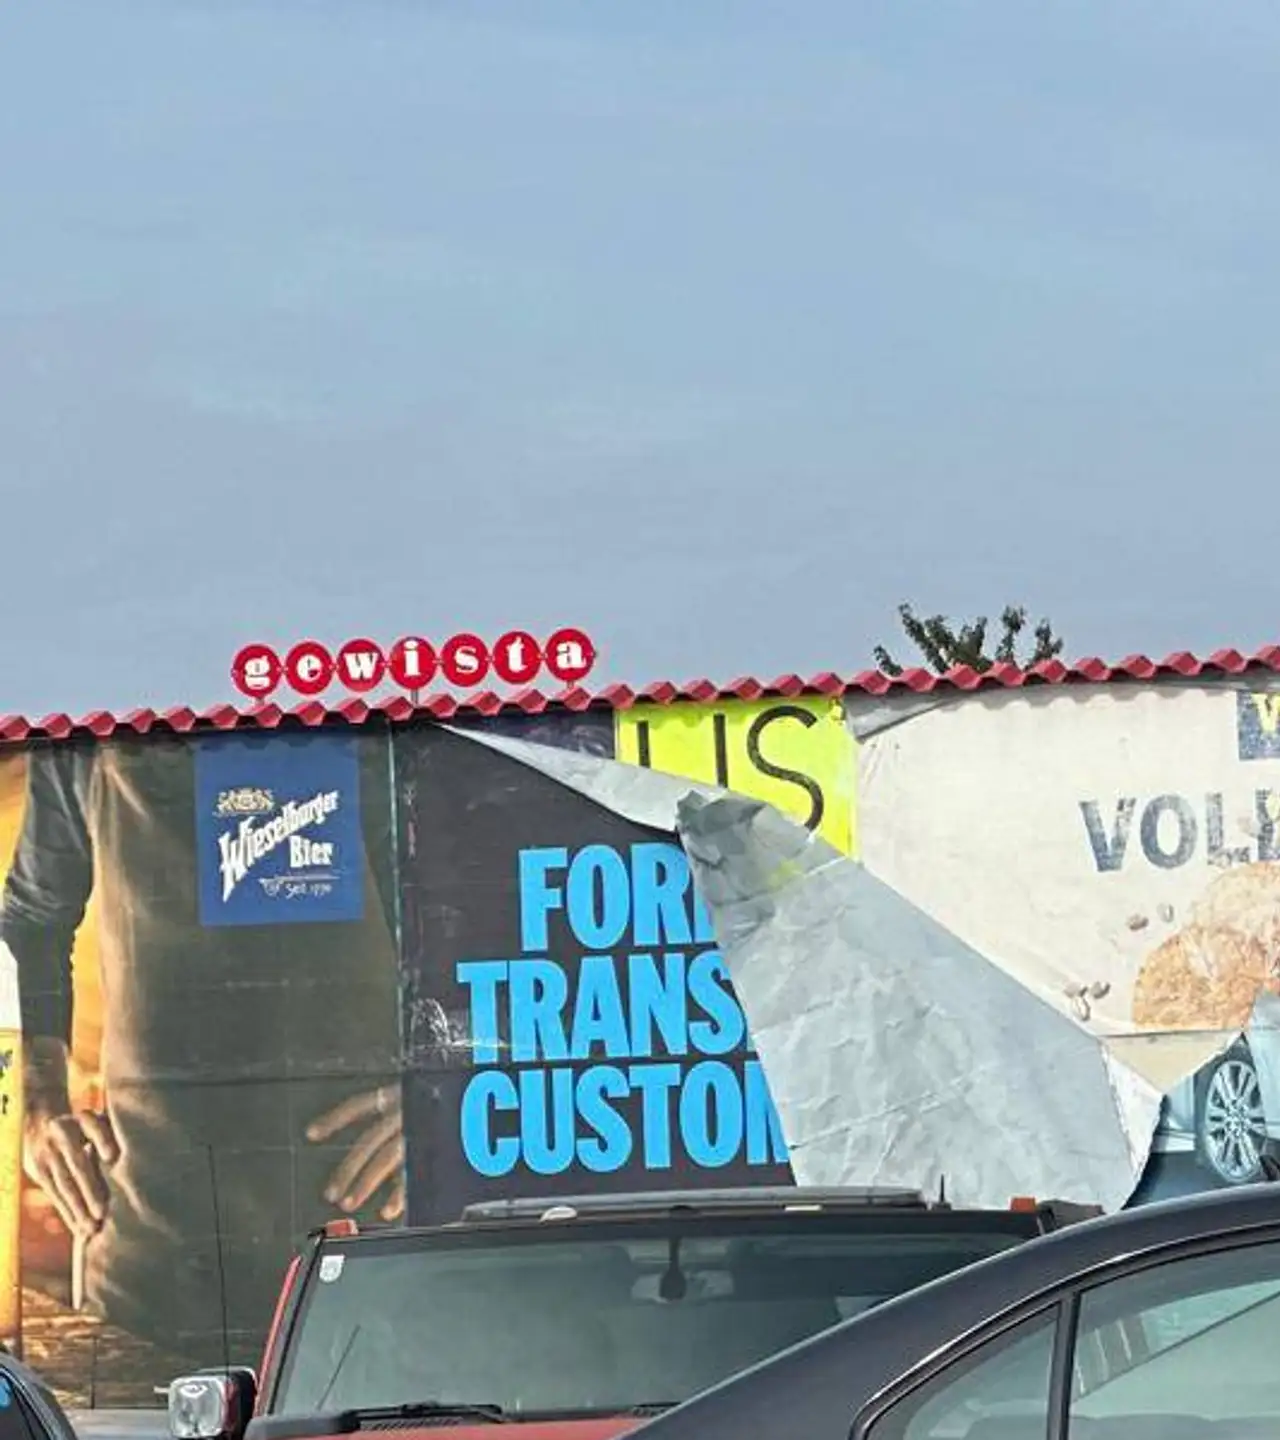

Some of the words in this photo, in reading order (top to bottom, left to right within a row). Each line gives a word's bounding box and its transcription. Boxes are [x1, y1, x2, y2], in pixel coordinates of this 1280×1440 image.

[244, 640, 586, 690] gewista
[217, 791, 339, 903] Wieselburger
[289, 835, 334, 868] Bier
